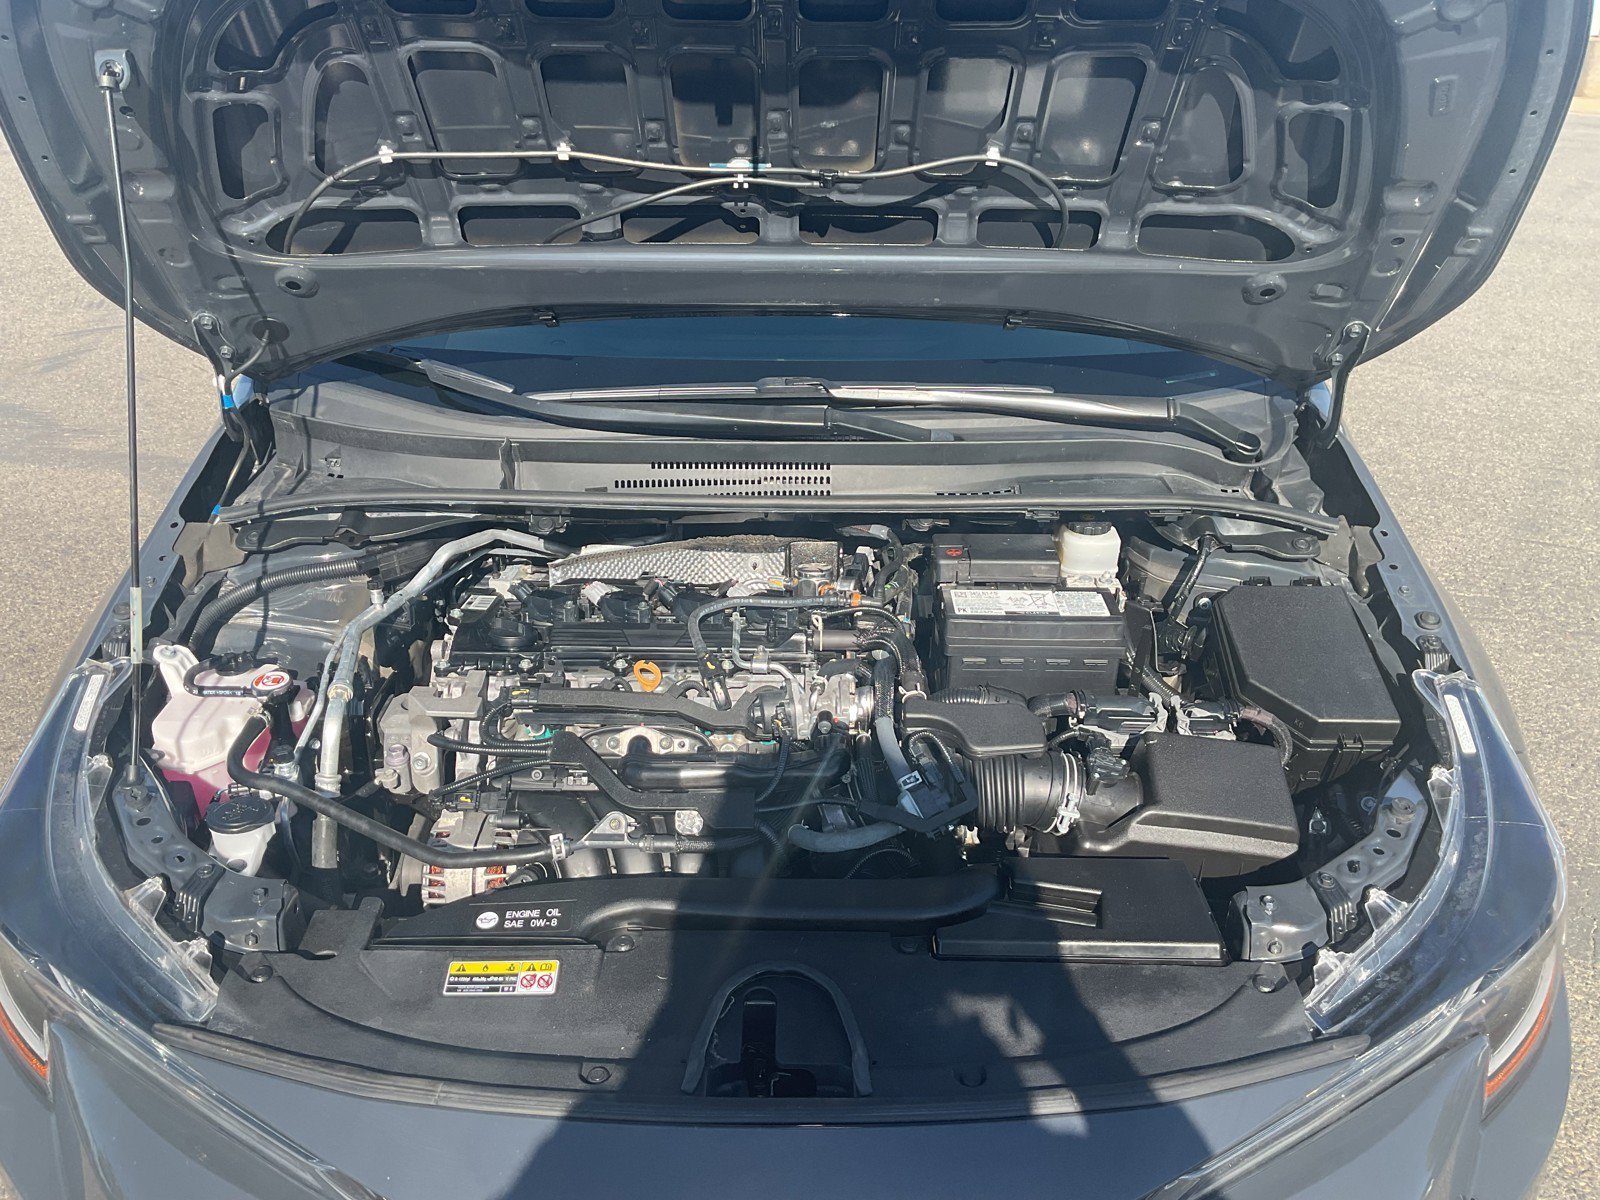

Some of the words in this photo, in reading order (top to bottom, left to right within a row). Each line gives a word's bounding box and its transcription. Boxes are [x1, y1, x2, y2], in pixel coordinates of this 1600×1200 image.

[505, 910, 540, 918] ENGINE
[546, 908, 561, 917] OIL
[504, 919, 524, 927] SAE
[530, 918, 558, 927] 0W-8
